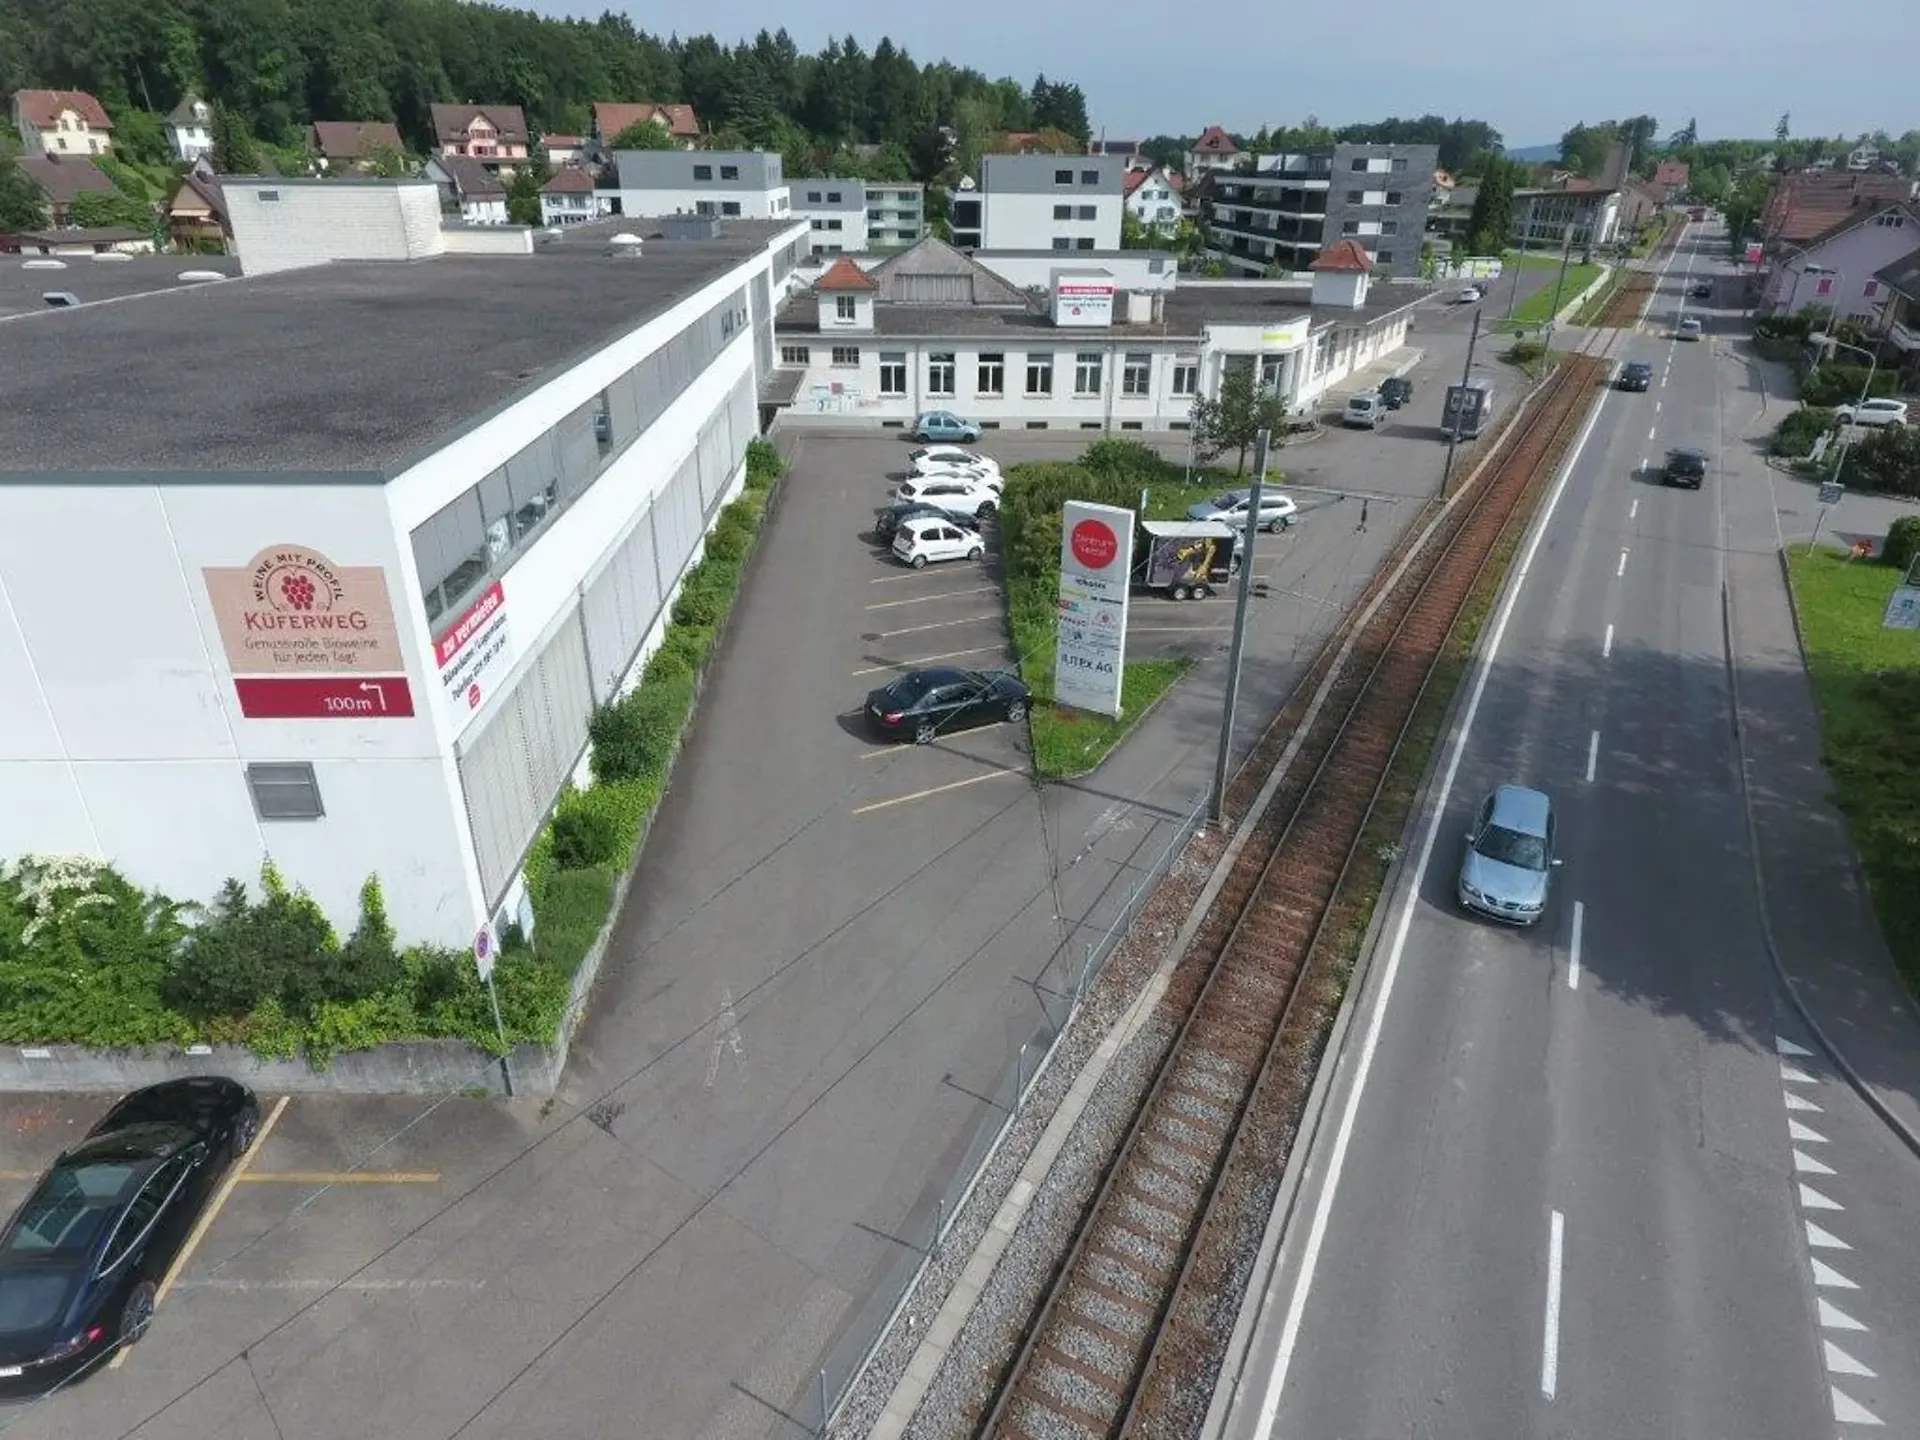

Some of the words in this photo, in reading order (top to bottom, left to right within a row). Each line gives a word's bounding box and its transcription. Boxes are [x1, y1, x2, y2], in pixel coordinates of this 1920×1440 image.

[254, 560, 273, 602] WEINE
[276, 554, 302, 562] MIT
[306, 558, 344, 601] PROFIL
[244, 611, 368, 630] KÜFERWEG
[293, 650, 329, 664] jeden
